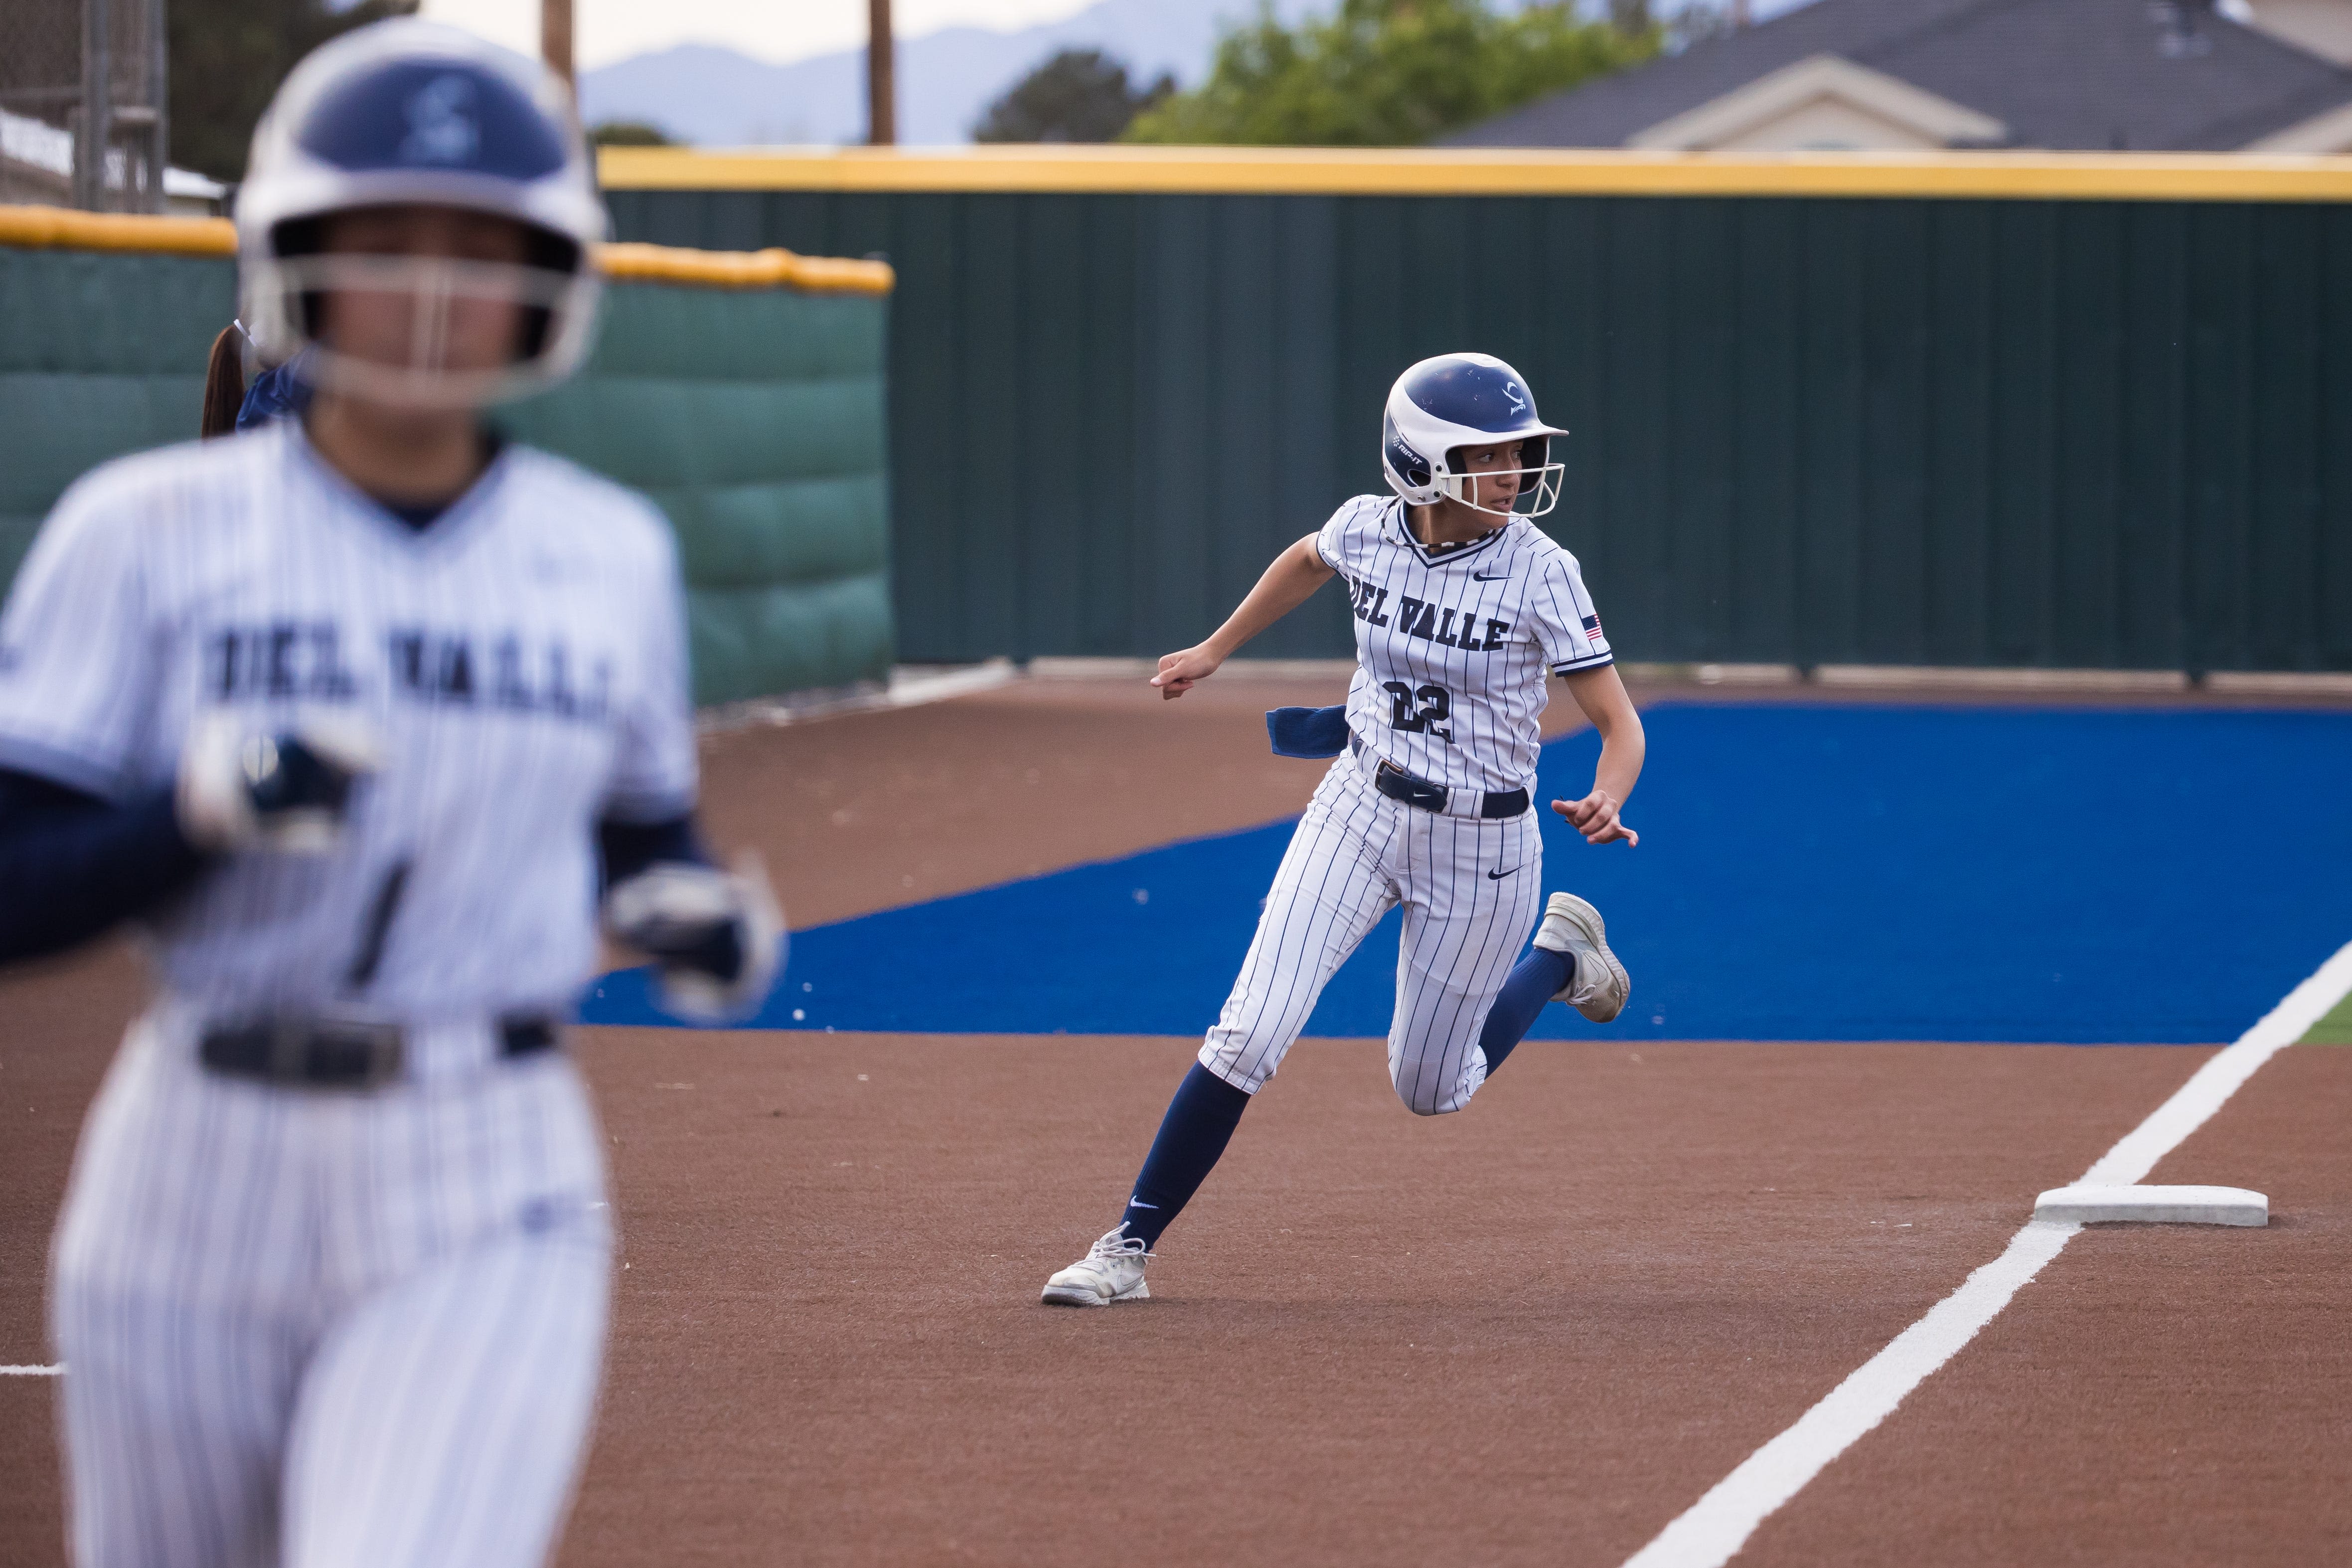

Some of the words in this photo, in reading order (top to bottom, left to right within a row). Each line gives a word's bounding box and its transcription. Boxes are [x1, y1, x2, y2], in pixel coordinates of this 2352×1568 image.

[1398, 444, 1422, 465] RIP-IT
[1351, 575, 1389, 628] DEL
[1400, 595, 1510, 652] VALLE
